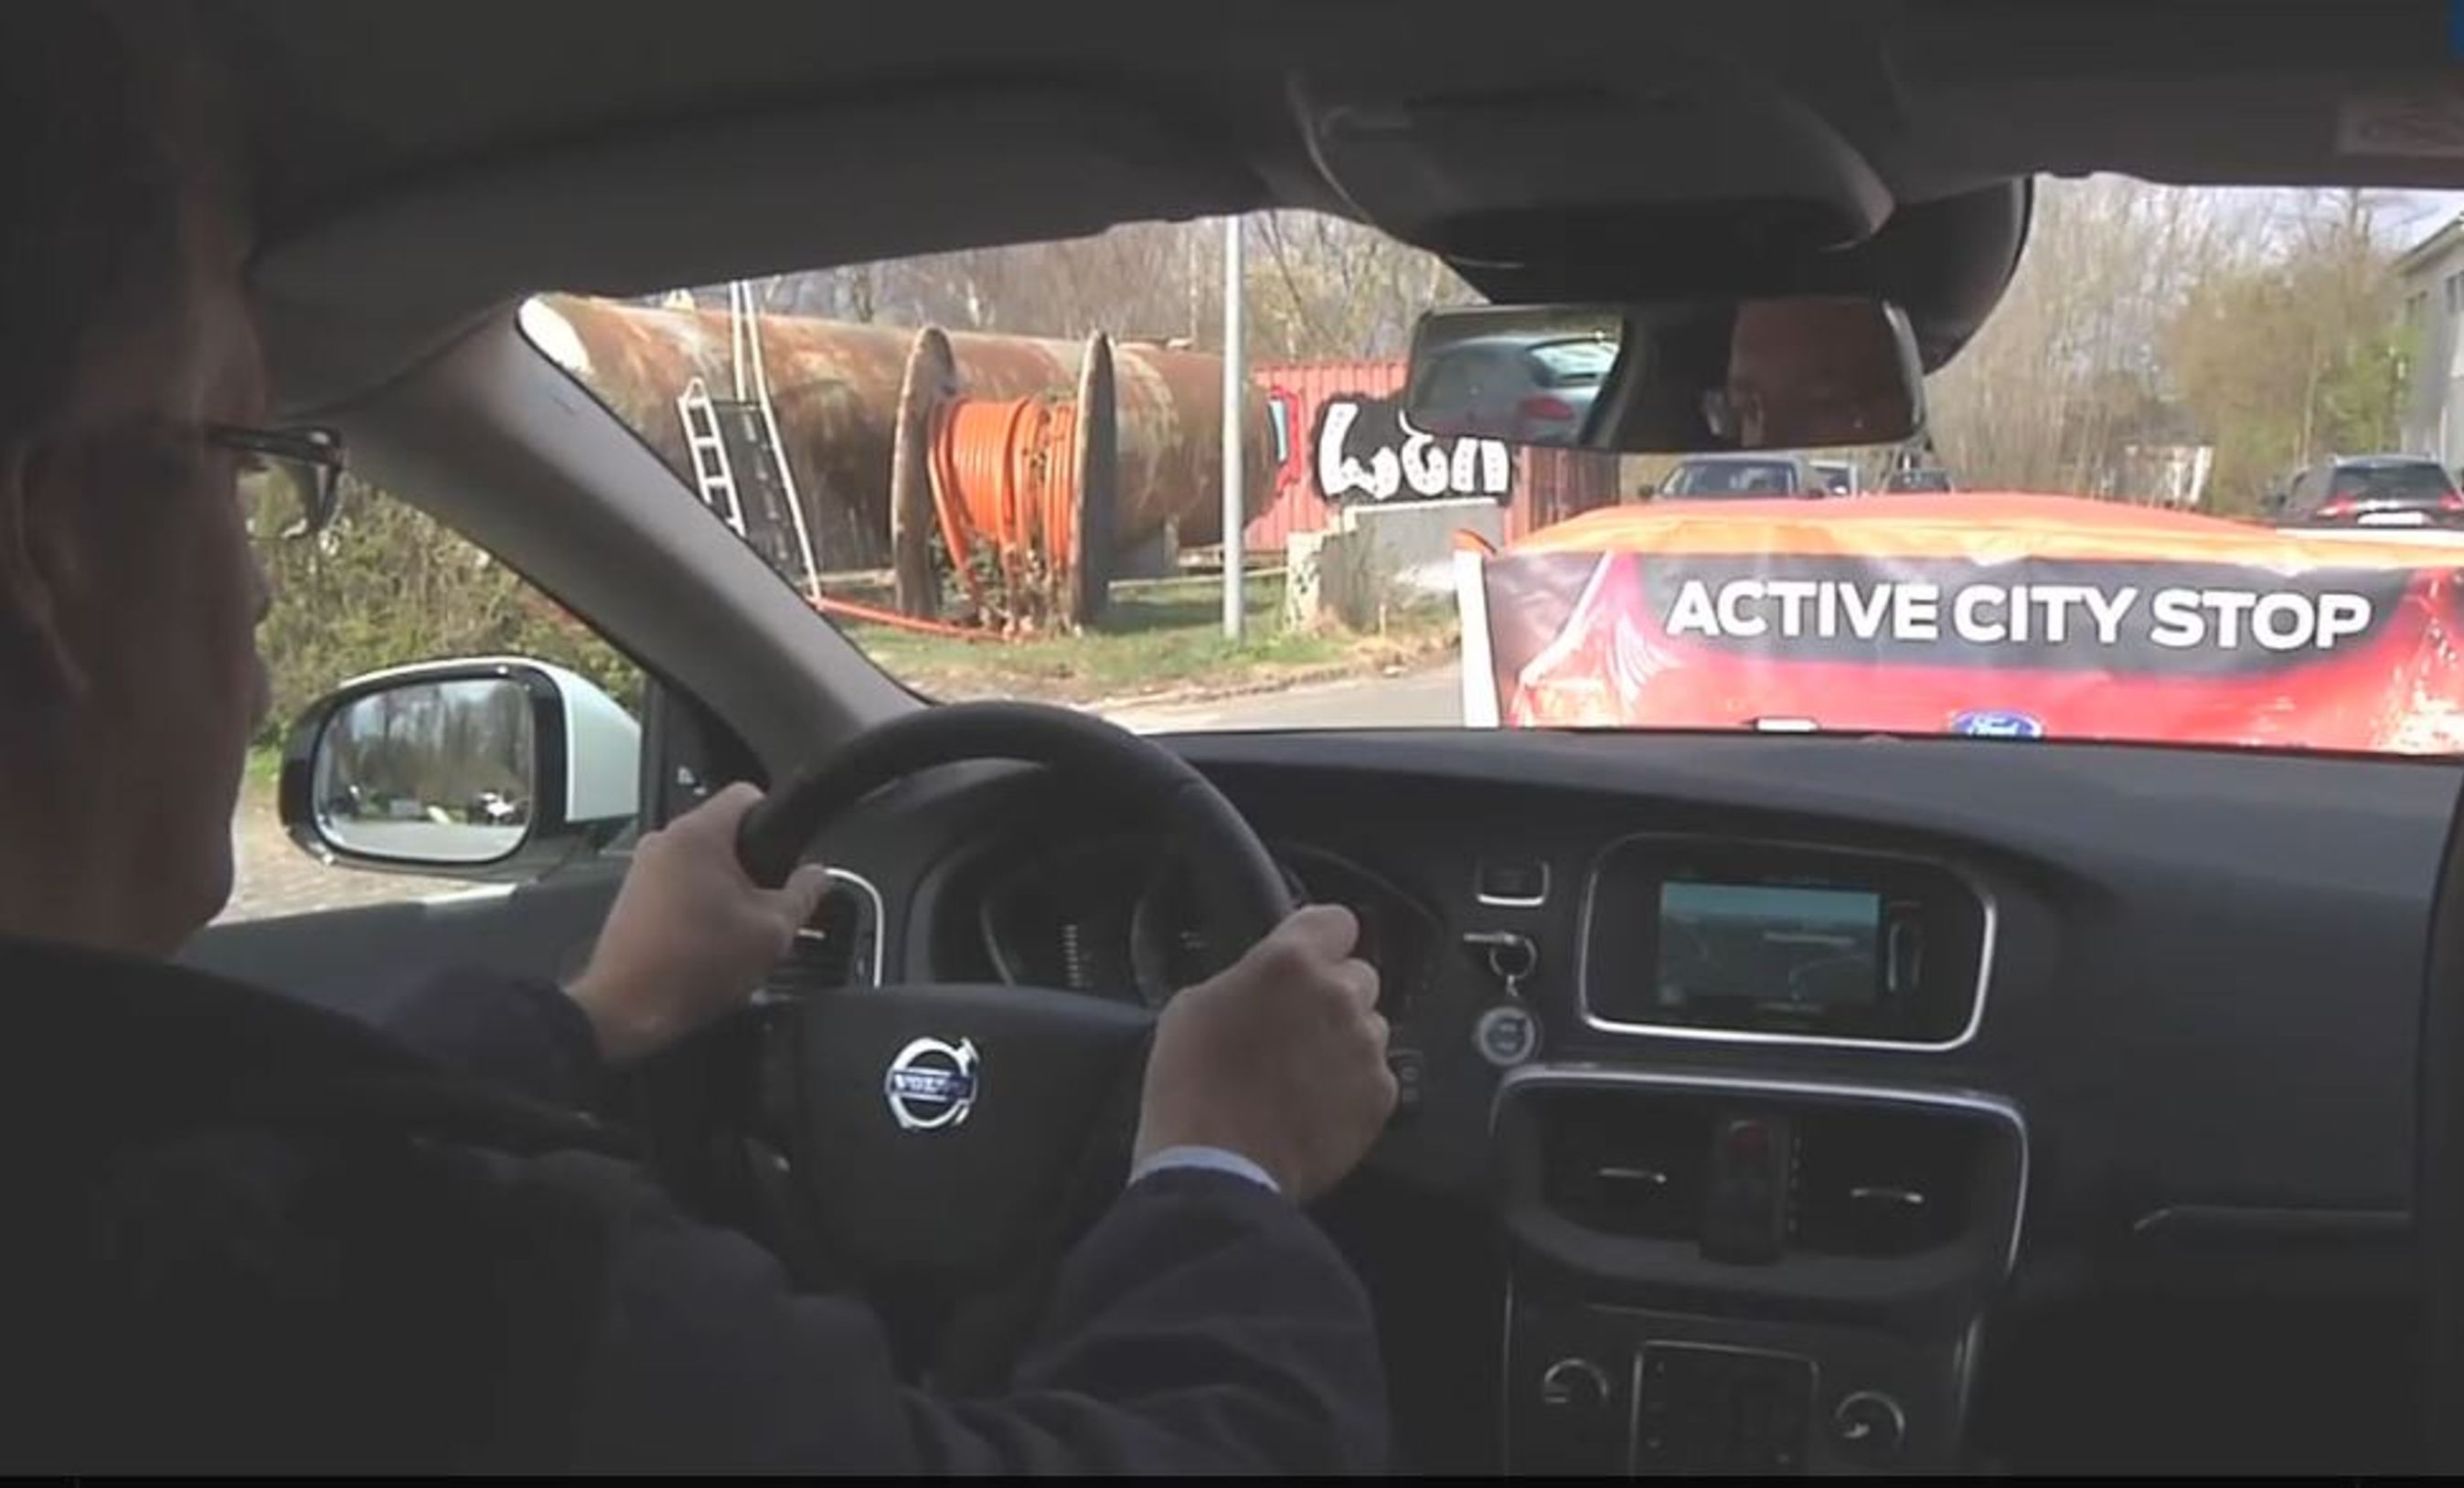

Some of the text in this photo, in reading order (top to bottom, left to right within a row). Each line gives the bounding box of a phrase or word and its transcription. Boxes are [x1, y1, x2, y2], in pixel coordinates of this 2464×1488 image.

[1665, 579, 2372, 650] ACTIVE CITY STOP
